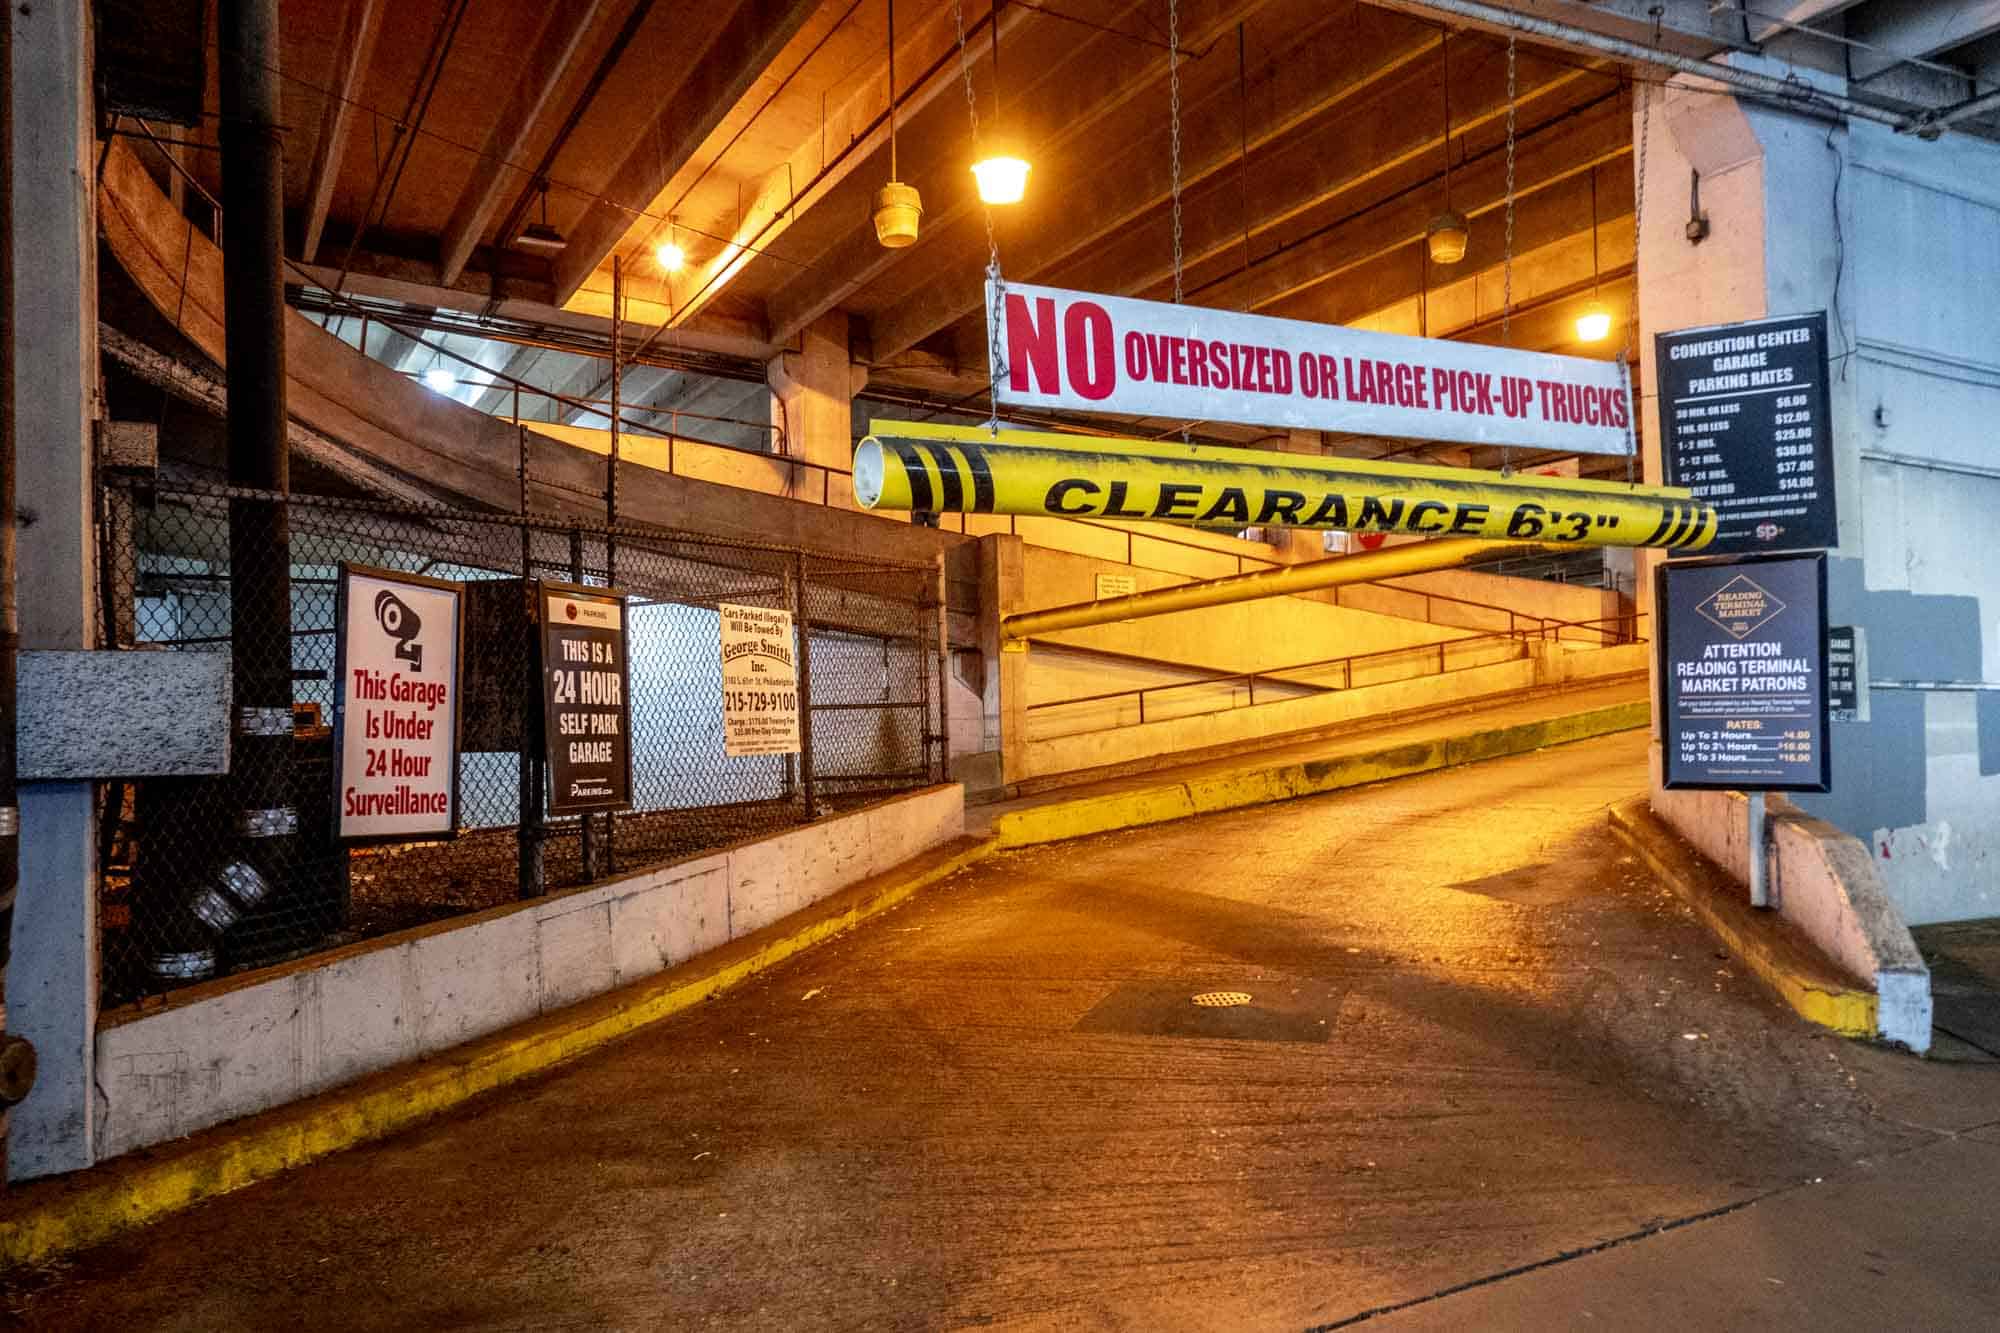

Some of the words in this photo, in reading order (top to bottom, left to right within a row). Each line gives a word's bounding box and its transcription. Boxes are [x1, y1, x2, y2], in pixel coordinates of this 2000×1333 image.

[1670, 335, 1755, 360] CONVENTION
[1757, 328, 1810, 349] CENTER
[1003, 292, 1117, 401] NO
[1124, 329, 1292, 394] OVERSIZED
[1299, 352, 1340, 397] OR
[1343, 359, 1429, 410] LARGE
[1432, 368, 1534, 420] PICK-UP
[1536, 379, 1630, 430] TRUCKS
[1713, 351, 1768, 372] GARAGE
[1689, 372, 1749, 394] PARKING
[1751, 367, 1794, 386] RATES
[1707, 405, 1719, 415] OR
[1720, 402, 1740, 414] LESS
[1697, 422, 1709, 433] OR
[1710, 420, 1730, 432] LESS
[1775, 426, 1812, 442] $25.00
[1776, 443, 1813, 458] $30.00
[1695, 471, 1706, 481] 24
[1777, 460, 1814, 474] $37.00
[1691, 485, 1710, 497] RLY
[1710, 482, 1735, 496] BIRD
[1779, 476, 1814, 490] $14.00
[1043, 478, 1490, 536] CLEARANCE
[1505, 503, 1619, 542] 6'3"
[1713, 599, 1768, 611] TERMINAL
[1717, 591, 1762, 602] READING
[723, 607, 738, 618] Cars
[739, 609, 763, 621] Parked
[764, 611, 788, 626] Illegally
[1718, 608, 1762, 619] MARKET
[730, 620, 743, 632] Will
[744, 622, 753, 632] Be
[754, 623, 774, 635] Towed
[775, 624, 783, 638] By
[561, 639, 589, 662] THIS
[592, 641, 603, 664] IS
[605, 643, 614, 665] A
[724, 640, 758, 658] George
[761, 637, 791, 663] Smith
[1703, 642, 1781, 659] ATTENTION
[751, 660, 767, 672] Inc.
[1677, 660, 1737, 677] READING
[1739, 658, 1813, 675] TERMINAL
[353, 668, 390, 700] This
[393, 672, 447, 706] Garage
[553, 669, 577, 704] 24
[580, 671, 621, 706] HOUR
[1681, 677, 1739, 693] MARKET
[1741, 675, 1808, 692] PATRONS
[725, 691, 795, 712] 215-729-9100
[365, 710, 380, 739] Is
[383, 711, 434, 740] Under
[560, 713, 588, 735] SELF
[591, 713, 619, 735] PARK
[1681, 731, 1695, 740] Up
[1698, 731, 1710, 740] To
[1711, 731, 1719, 740] 2
[569, 741, 613, 764] GARAGE
[1681, 742, 1696, 751] Up
[1697, 742, 1710, 751] To
[365, 749, 388, 778] 24
[391, 749, 431, 778] Hour
[1681, 753, 1695, 763] Up
[1695, 753, 1709, 762] To
[1710, 753, 1717, 762] 3
[345, 784, 448, 817] Surveillance
